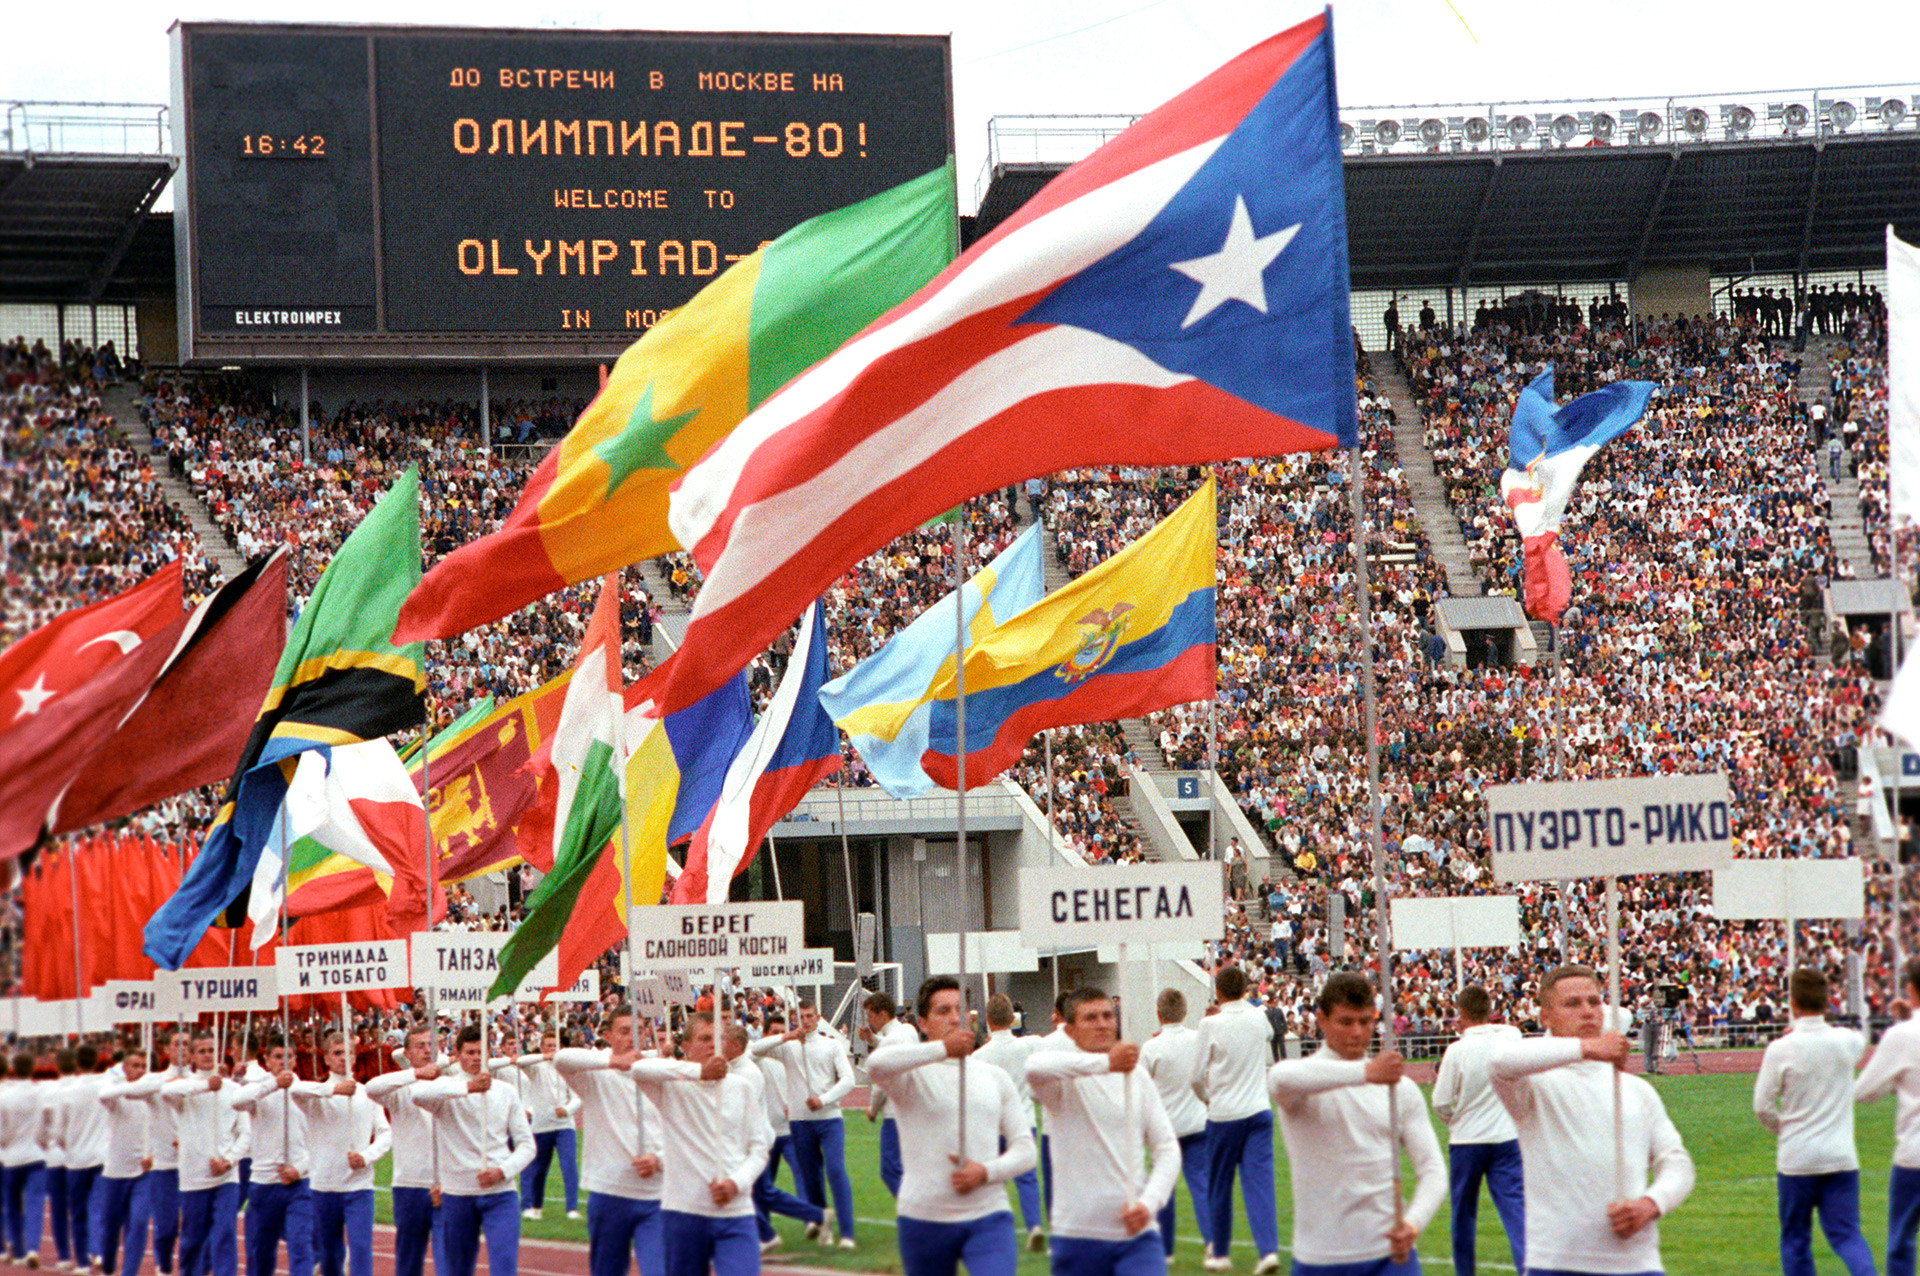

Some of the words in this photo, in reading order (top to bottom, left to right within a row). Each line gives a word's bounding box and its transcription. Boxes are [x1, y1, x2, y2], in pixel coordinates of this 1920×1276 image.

[450, 68, 481, 88] ДО
[500, 69, 615, 90] ВСТРЕЧИ
[650, 71, 664, 90] В
[699, 72, 795, 92] МОСКВЕ
[813, 73, 844, 92] НА
[243, 135, 326, 155] 16:42
[453, 118, 868, 158] ОЛИМПИАДЕ-80!
[554, 190, 669, 209] WELCOME
[704, 191, 735, 209] TO
[458, 239, 776, 275] OLYMPIAD-
[235, 311, 342, 325] ELEKTROIMPEX
[561, 310, 591, 329] IN
[1184, 781, 1192, 795] 5
[1493, 800, 1732, 853] ПУЭРТО-РИКО
[1052, 885, 1193, 924] СЕНЕГАЛ
[682, 914, 754, 935] БЕРЕГ
[645, 934, 728, 959] СЛОНОВОЙ
[739, 935, 788, 957] КОСТИ
[295, 947, 389, 969] ТРИНИДАД
[299, 971, 310, 987] И
[319, 965, 387, 986] ТОБАГО
[180, 978, 258, 1000] ТУРЦИЯ
